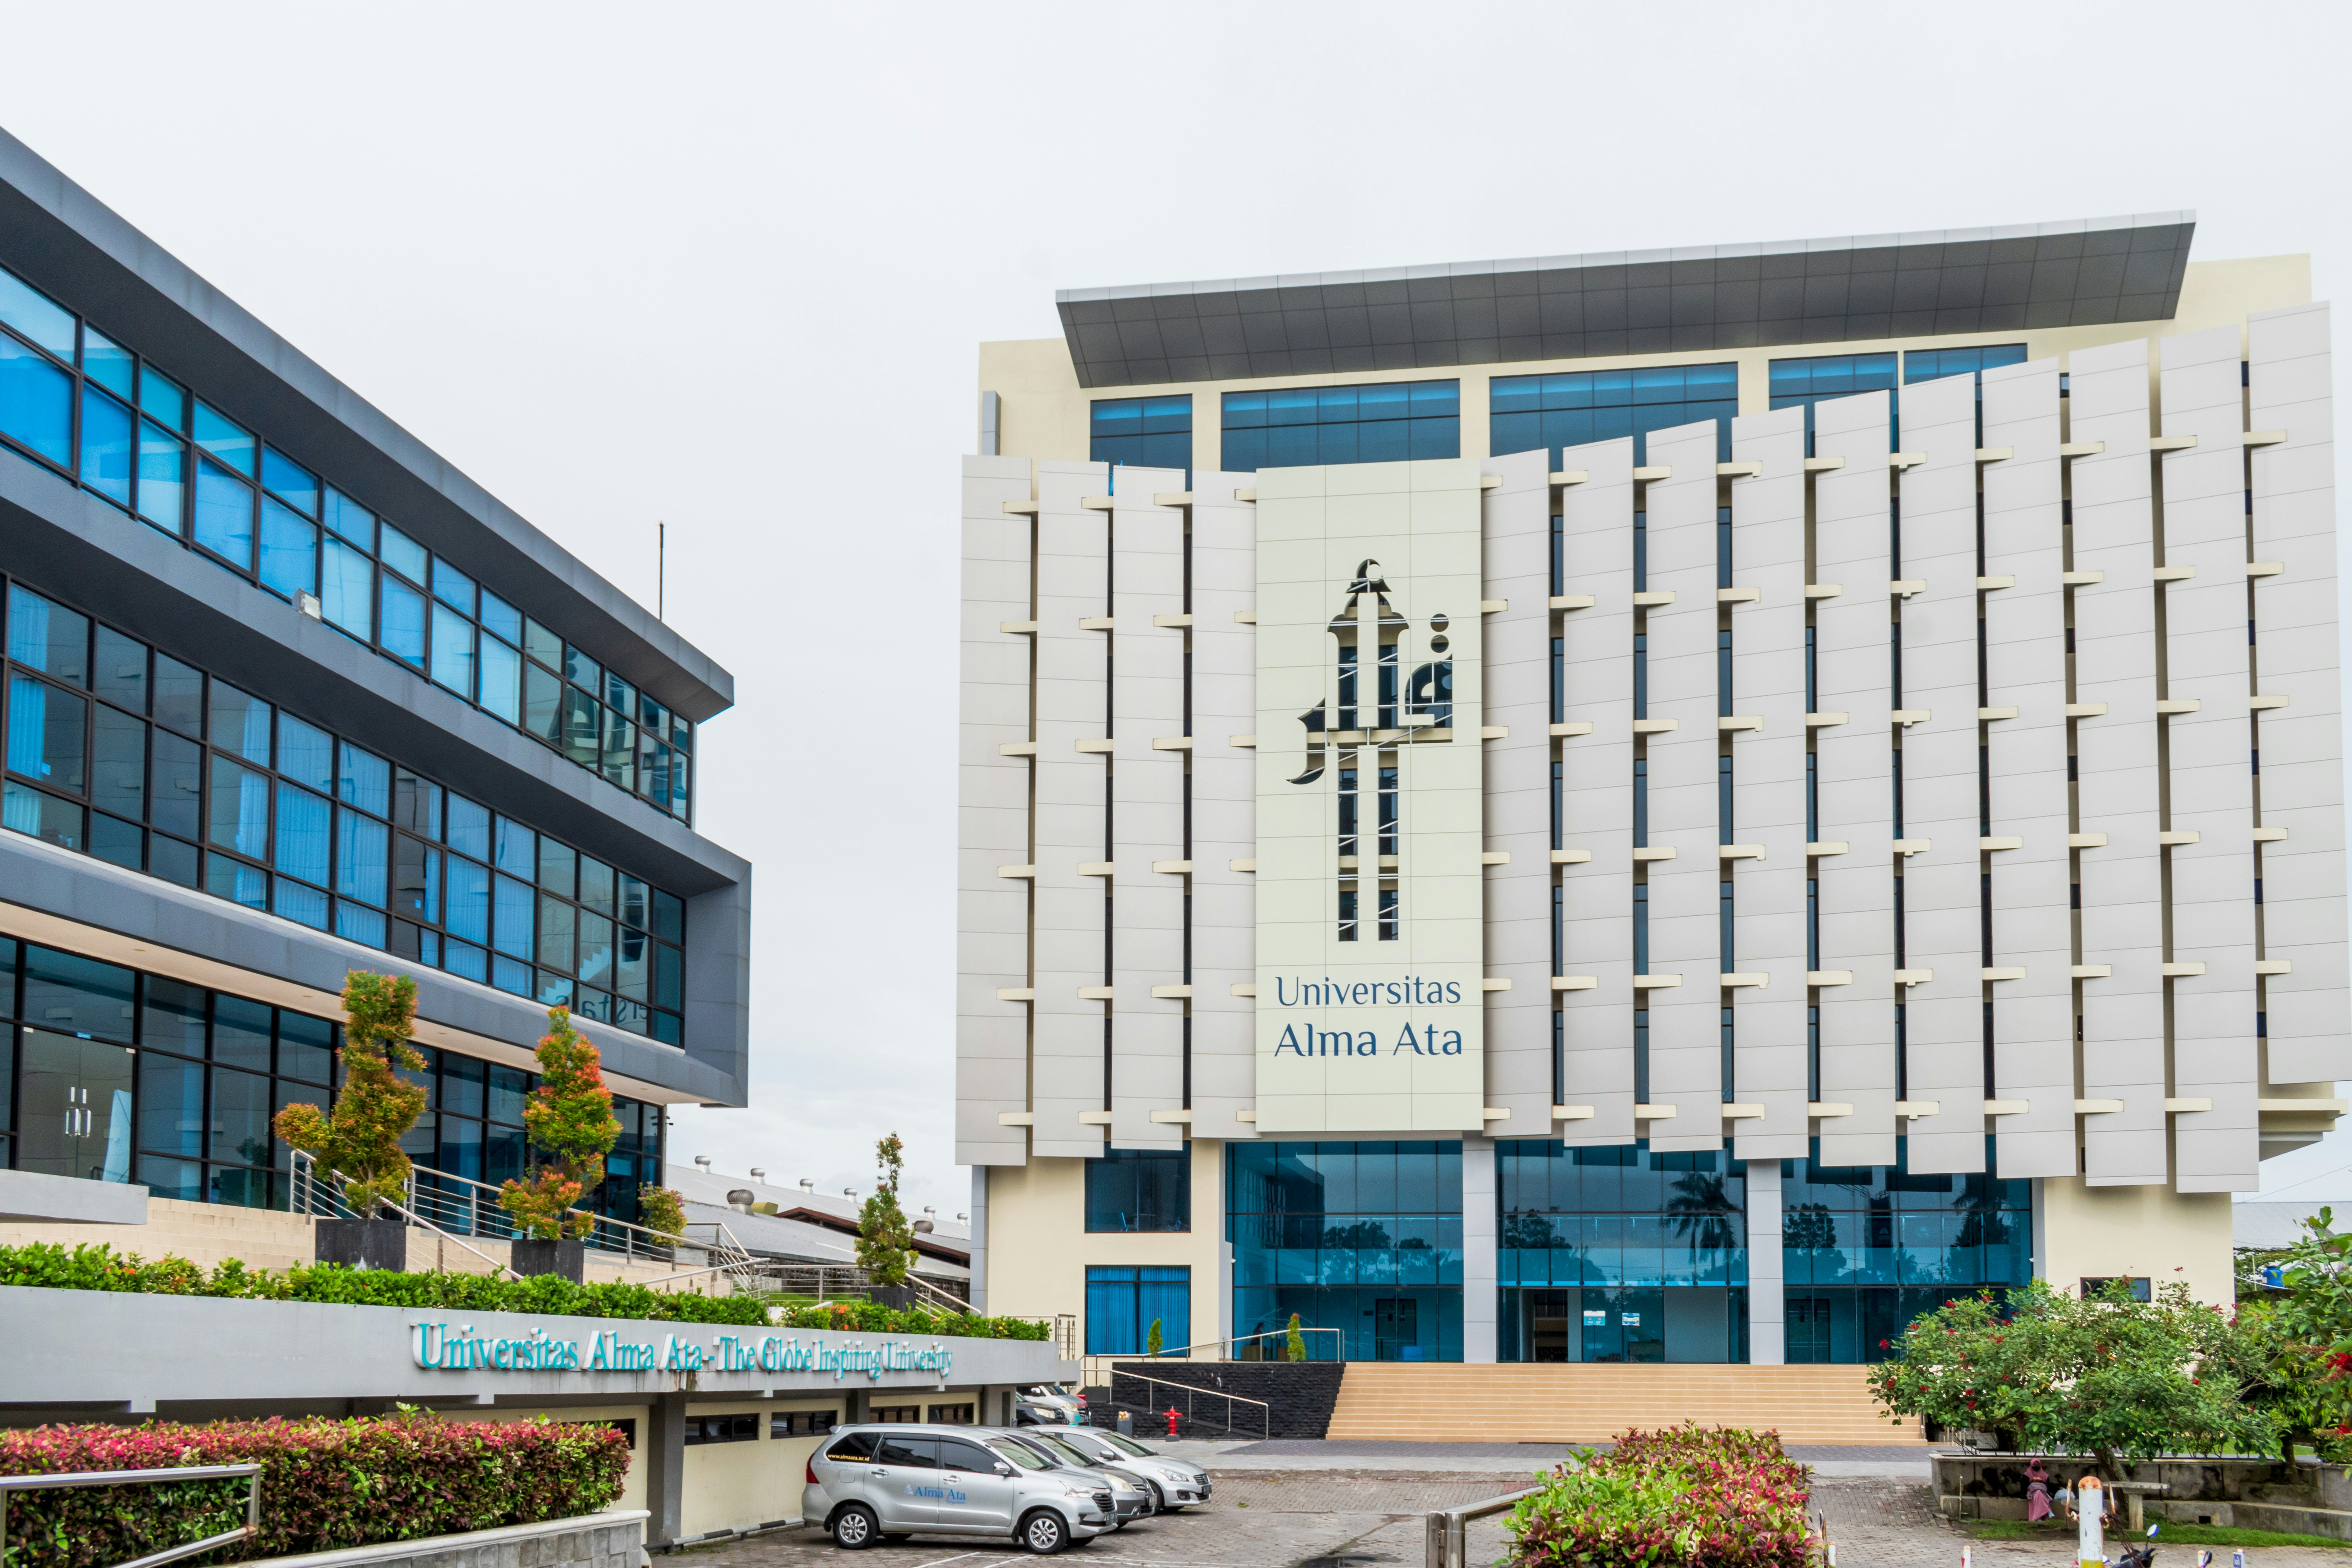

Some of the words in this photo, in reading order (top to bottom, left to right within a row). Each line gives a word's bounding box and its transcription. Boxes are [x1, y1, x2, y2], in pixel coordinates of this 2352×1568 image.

[1275, 975, 1461, 1006] Universitas
[1274, 1023, 1376, 1057] Alma
[1393, 1022, 1461, 1055] Ata
[416, 1323, 578, 1370] Universitas
[586, 1331, 655, 1370] Alma
[662, 1336, 702, 1370] Ata
[719, 1337, 755, 1371] The
[761, 1337, 812, 1371] Globe
[817, 1341, 881, 1379] Inspiring
[885, 1342, 952, 1377] University
[914, 1486, 944, 1498] Alma
[947, 1488, 966, 1500] Ata
